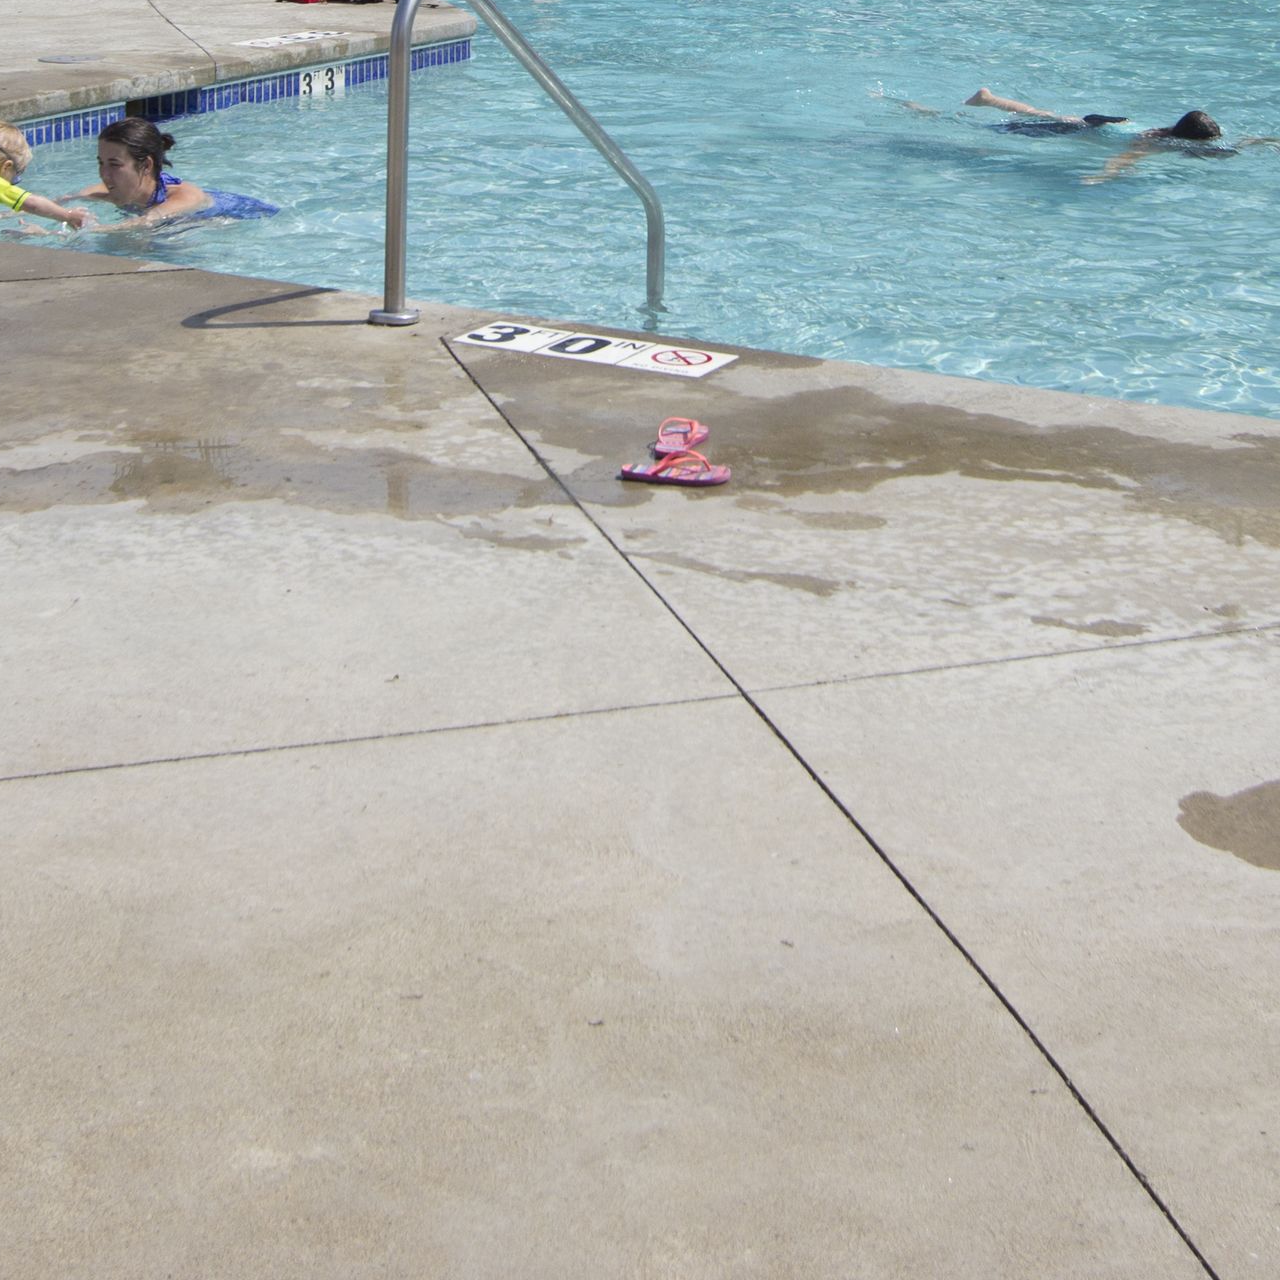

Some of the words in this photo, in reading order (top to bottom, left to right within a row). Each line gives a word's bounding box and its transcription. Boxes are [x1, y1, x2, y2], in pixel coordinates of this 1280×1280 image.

[302, 72, 312, 95] 3
[313, 70, 321, 80] FT
[324, 67, 335, 91] 3
[336, 64, 343, 75] IN
[466, 325, 531, 343] 3
[530, 329, 560, 340] FT
[547, 336, 613, 354] 0
[614, 340, 647, 351] IN
